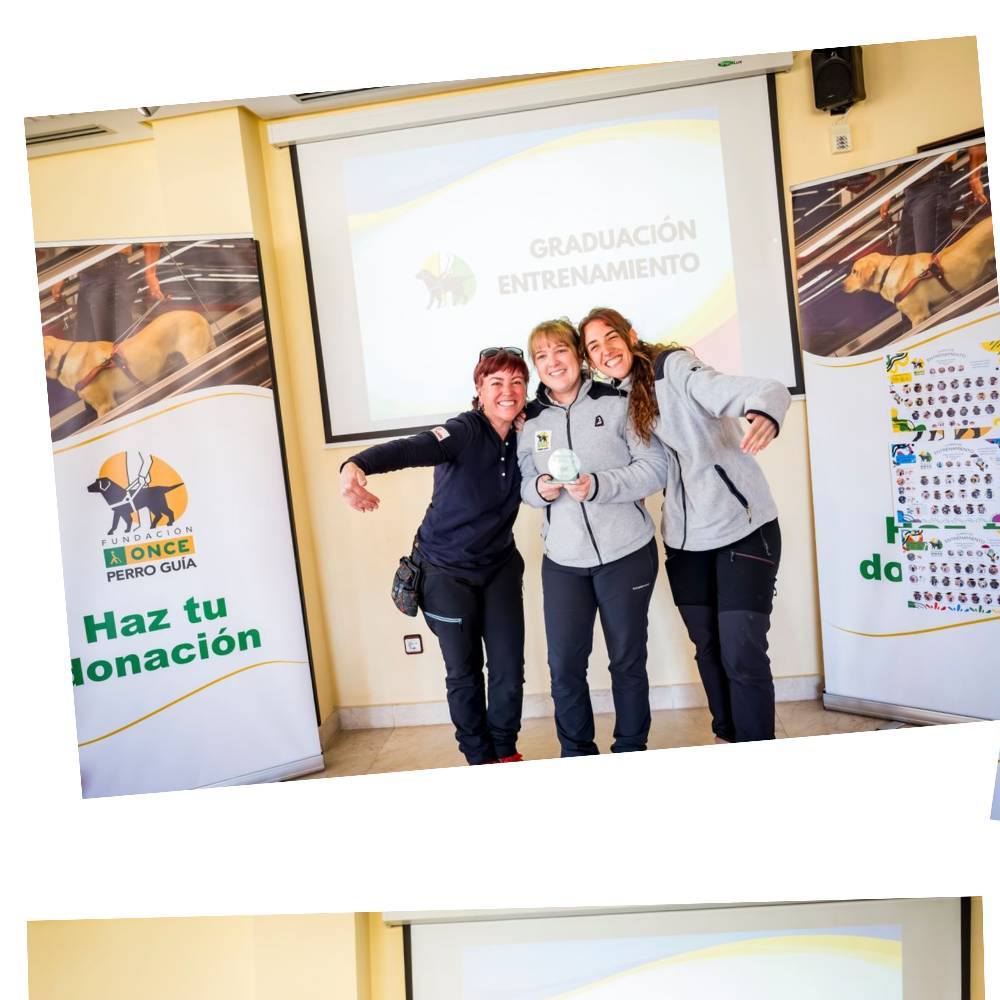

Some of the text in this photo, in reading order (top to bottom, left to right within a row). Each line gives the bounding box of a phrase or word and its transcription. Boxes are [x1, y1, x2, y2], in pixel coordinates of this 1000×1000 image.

[529, 215, 697, 258] GRADUACIÓN
[497, 252, 700, 295] ENTRENAMIENTO
[101, 526, 193, 545] FUNDACIÓN
[130, 539, 190, 560] ONCE
[106, 556, 197, 582] PERRO GUÍA
[83, 595, 227, 643] Haz tu
